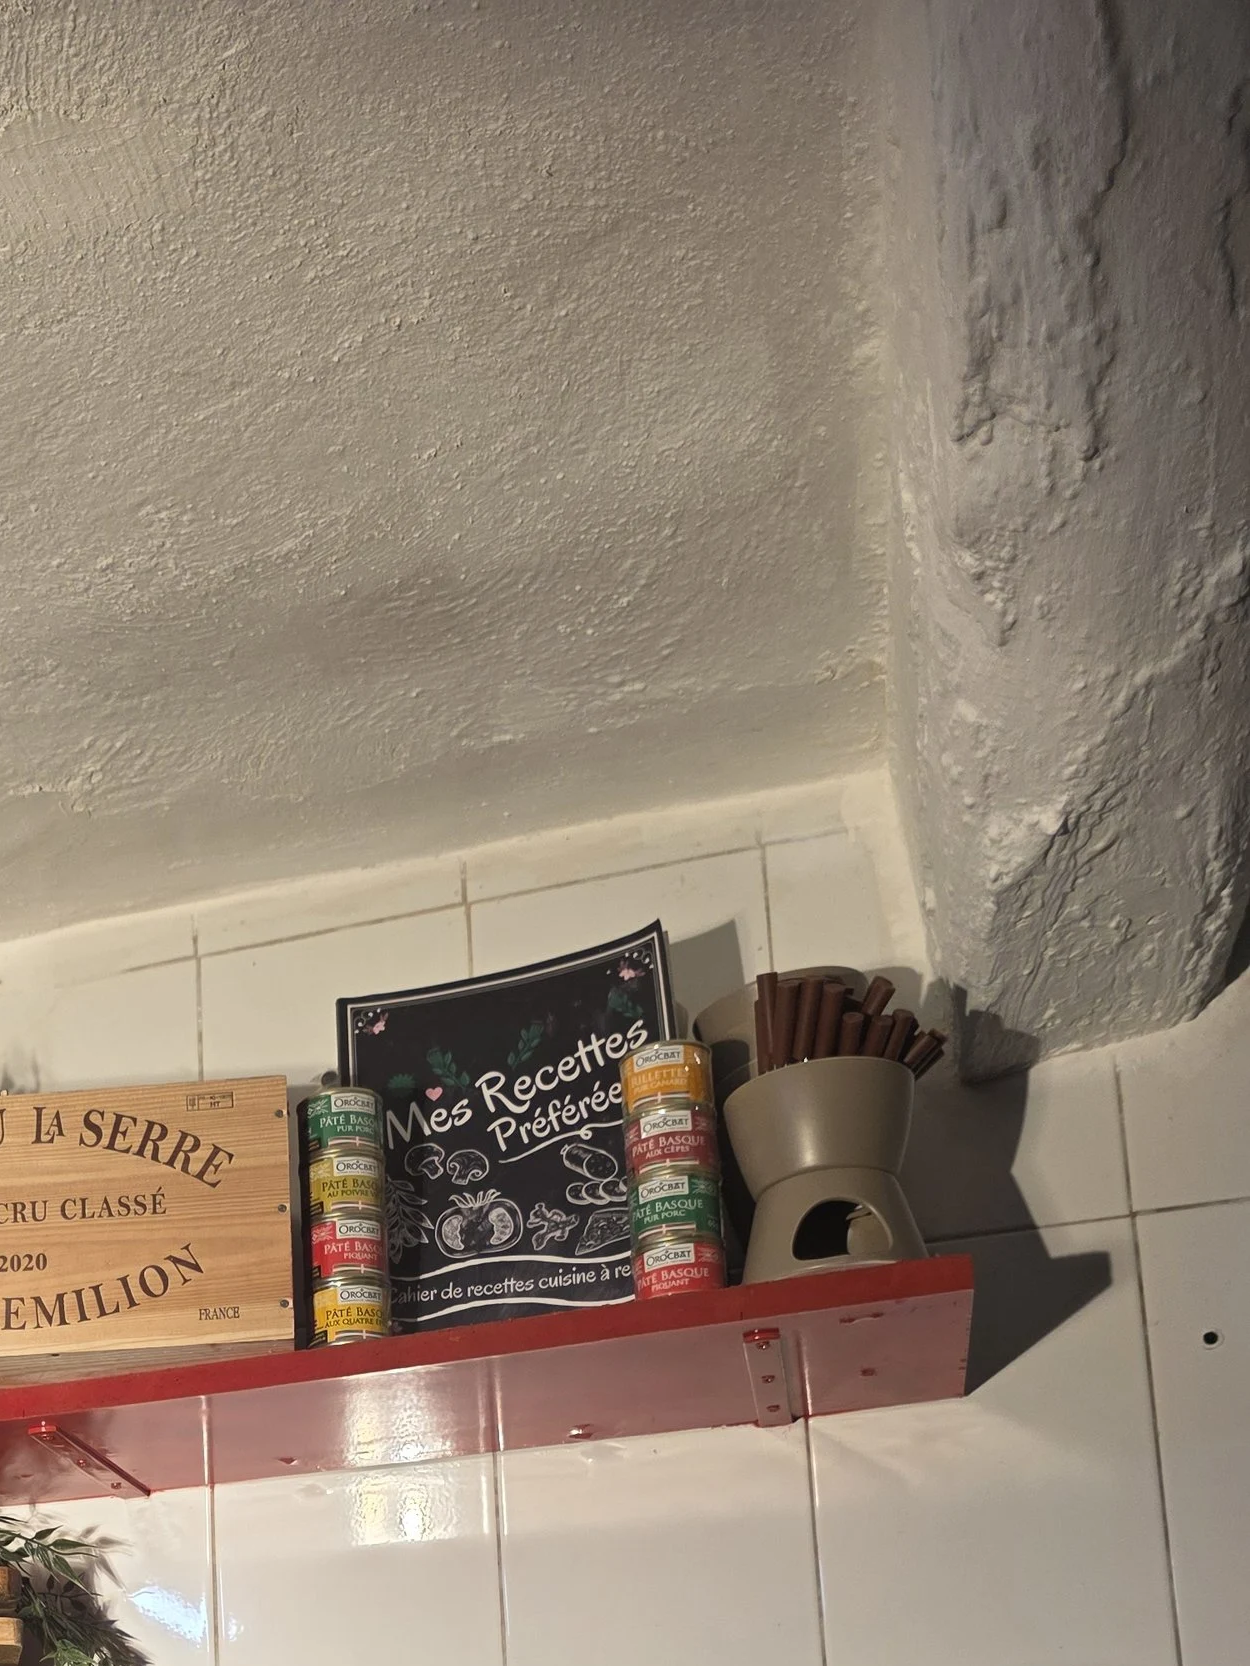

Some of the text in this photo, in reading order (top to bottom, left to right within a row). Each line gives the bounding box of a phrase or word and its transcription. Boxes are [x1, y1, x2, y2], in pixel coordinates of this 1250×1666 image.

[635, 1051, 681, 1067] OROCBAT
[386, 1019, 648, 1150] Mes Recettes
[319, 1114, 346, 1127] PÂTÉ
[486, 1080, 624, 1152] Préférée
[337, 1125, 353, 1133] PUR
[643, 1118, 689, 1133] OROCBAT
[659, 1135, 706, 1146] BASQUE
[79, 1109, 234, 1188] SERRE
[645, 1149, 662, 1159] AUX
[322, 1178, 349, 1192] PÂTÉ
[641, 1182, 685, 1199] OROCBAT
[327, 1190, 338, 1198] AU
[60, 1186, 167, 1220] CLASSÉ
[655, 1199, 704, 1212] BASQUE
[643, 1209, 686, 1225] PUR PORC
[324, 1241, 350, 1255] PÂTÉ
[646, 1250, 691, 1267] OROCBAT
[661, 1267, 710, 1280] BASQUE
[390, 1285, 438, 1304] Cahier
[440, 1281, 463, 1299] de
[467, 1277, 535, 1297] recettes
[538, 1266, 597, 1288] cuisine
[600, 1264, 610, 1281] à
[651, 1278, 690, 1293] PIQUANT
[199, 1306, 240, 1321] FRANCE
[326, 1306, 352, 1320] PÂTÉ
[325, 1320, 340, 1329] AUX
[342, 1317, 373, 1326] QUATRE
